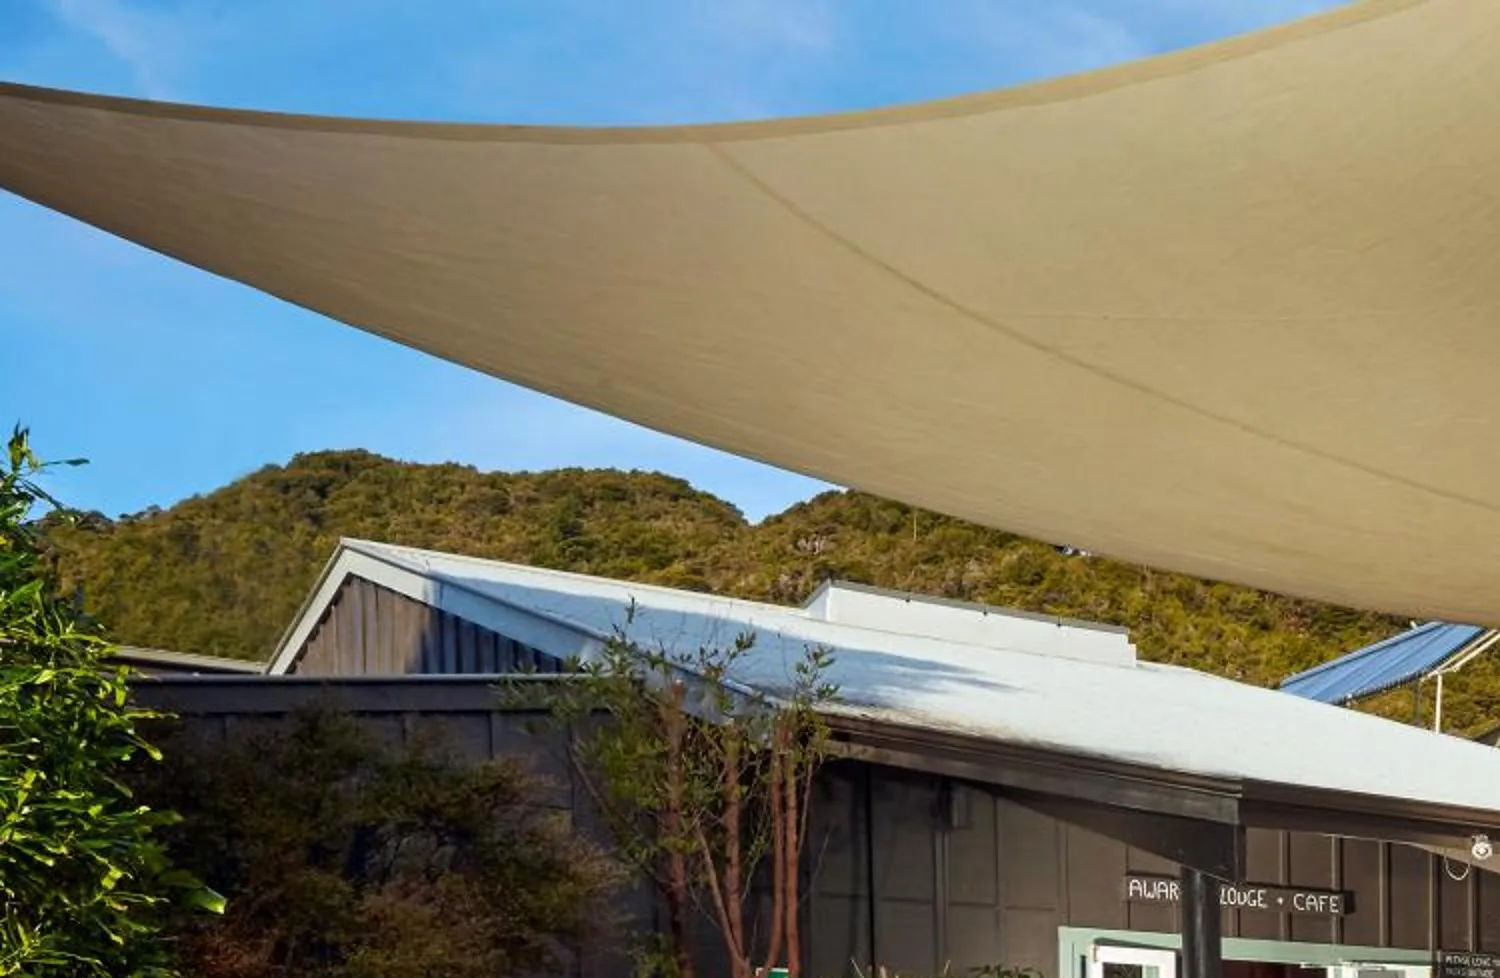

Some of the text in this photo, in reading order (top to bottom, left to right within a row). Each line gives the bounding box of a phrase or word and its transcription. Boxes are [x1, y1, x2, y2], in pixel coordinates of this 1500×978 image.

[1128, 878, 1340, 914] AWAR LODGE CAFE
